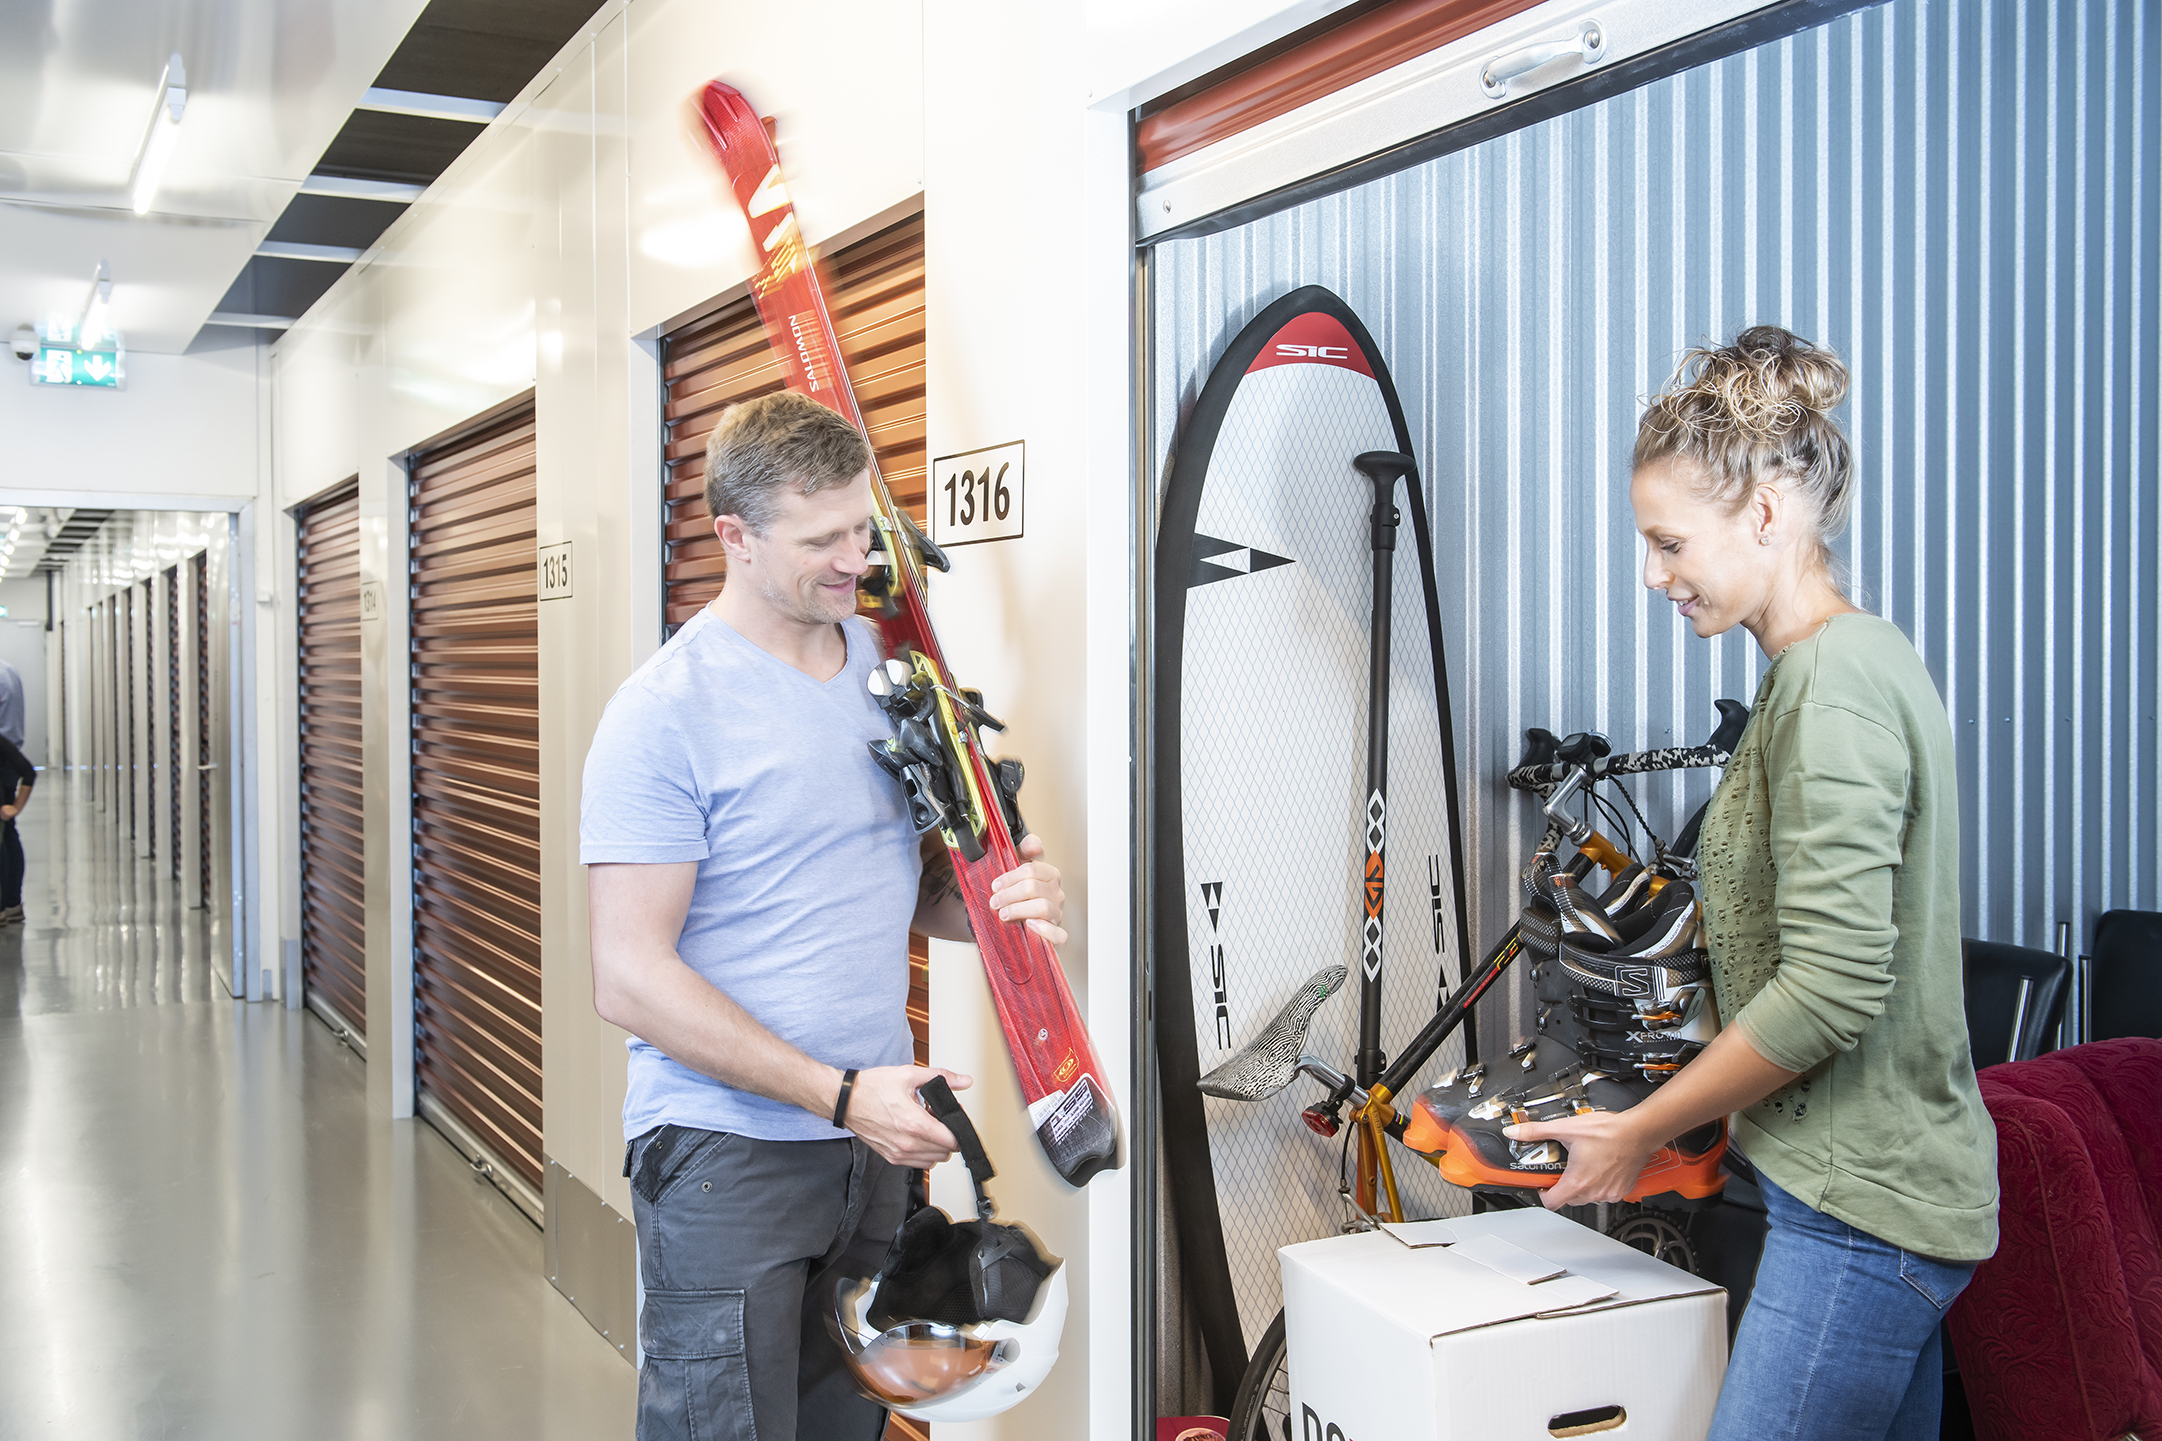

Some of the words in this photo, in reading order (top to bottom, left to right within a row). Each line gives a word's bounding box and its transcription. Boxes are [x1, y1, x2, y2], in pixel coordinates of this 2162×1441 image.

[788, 314, 820, 393] SALOMON
[1276, 344, 1348, 359] SIC
[944, 461, 1010, 526] 1316
[363, 589, 377, 612] 1314
[543, 553, 568, 589] 1315
[1428, 854, 1446, 955] SIC
[1210, 943, 1232, 1051] SIC
